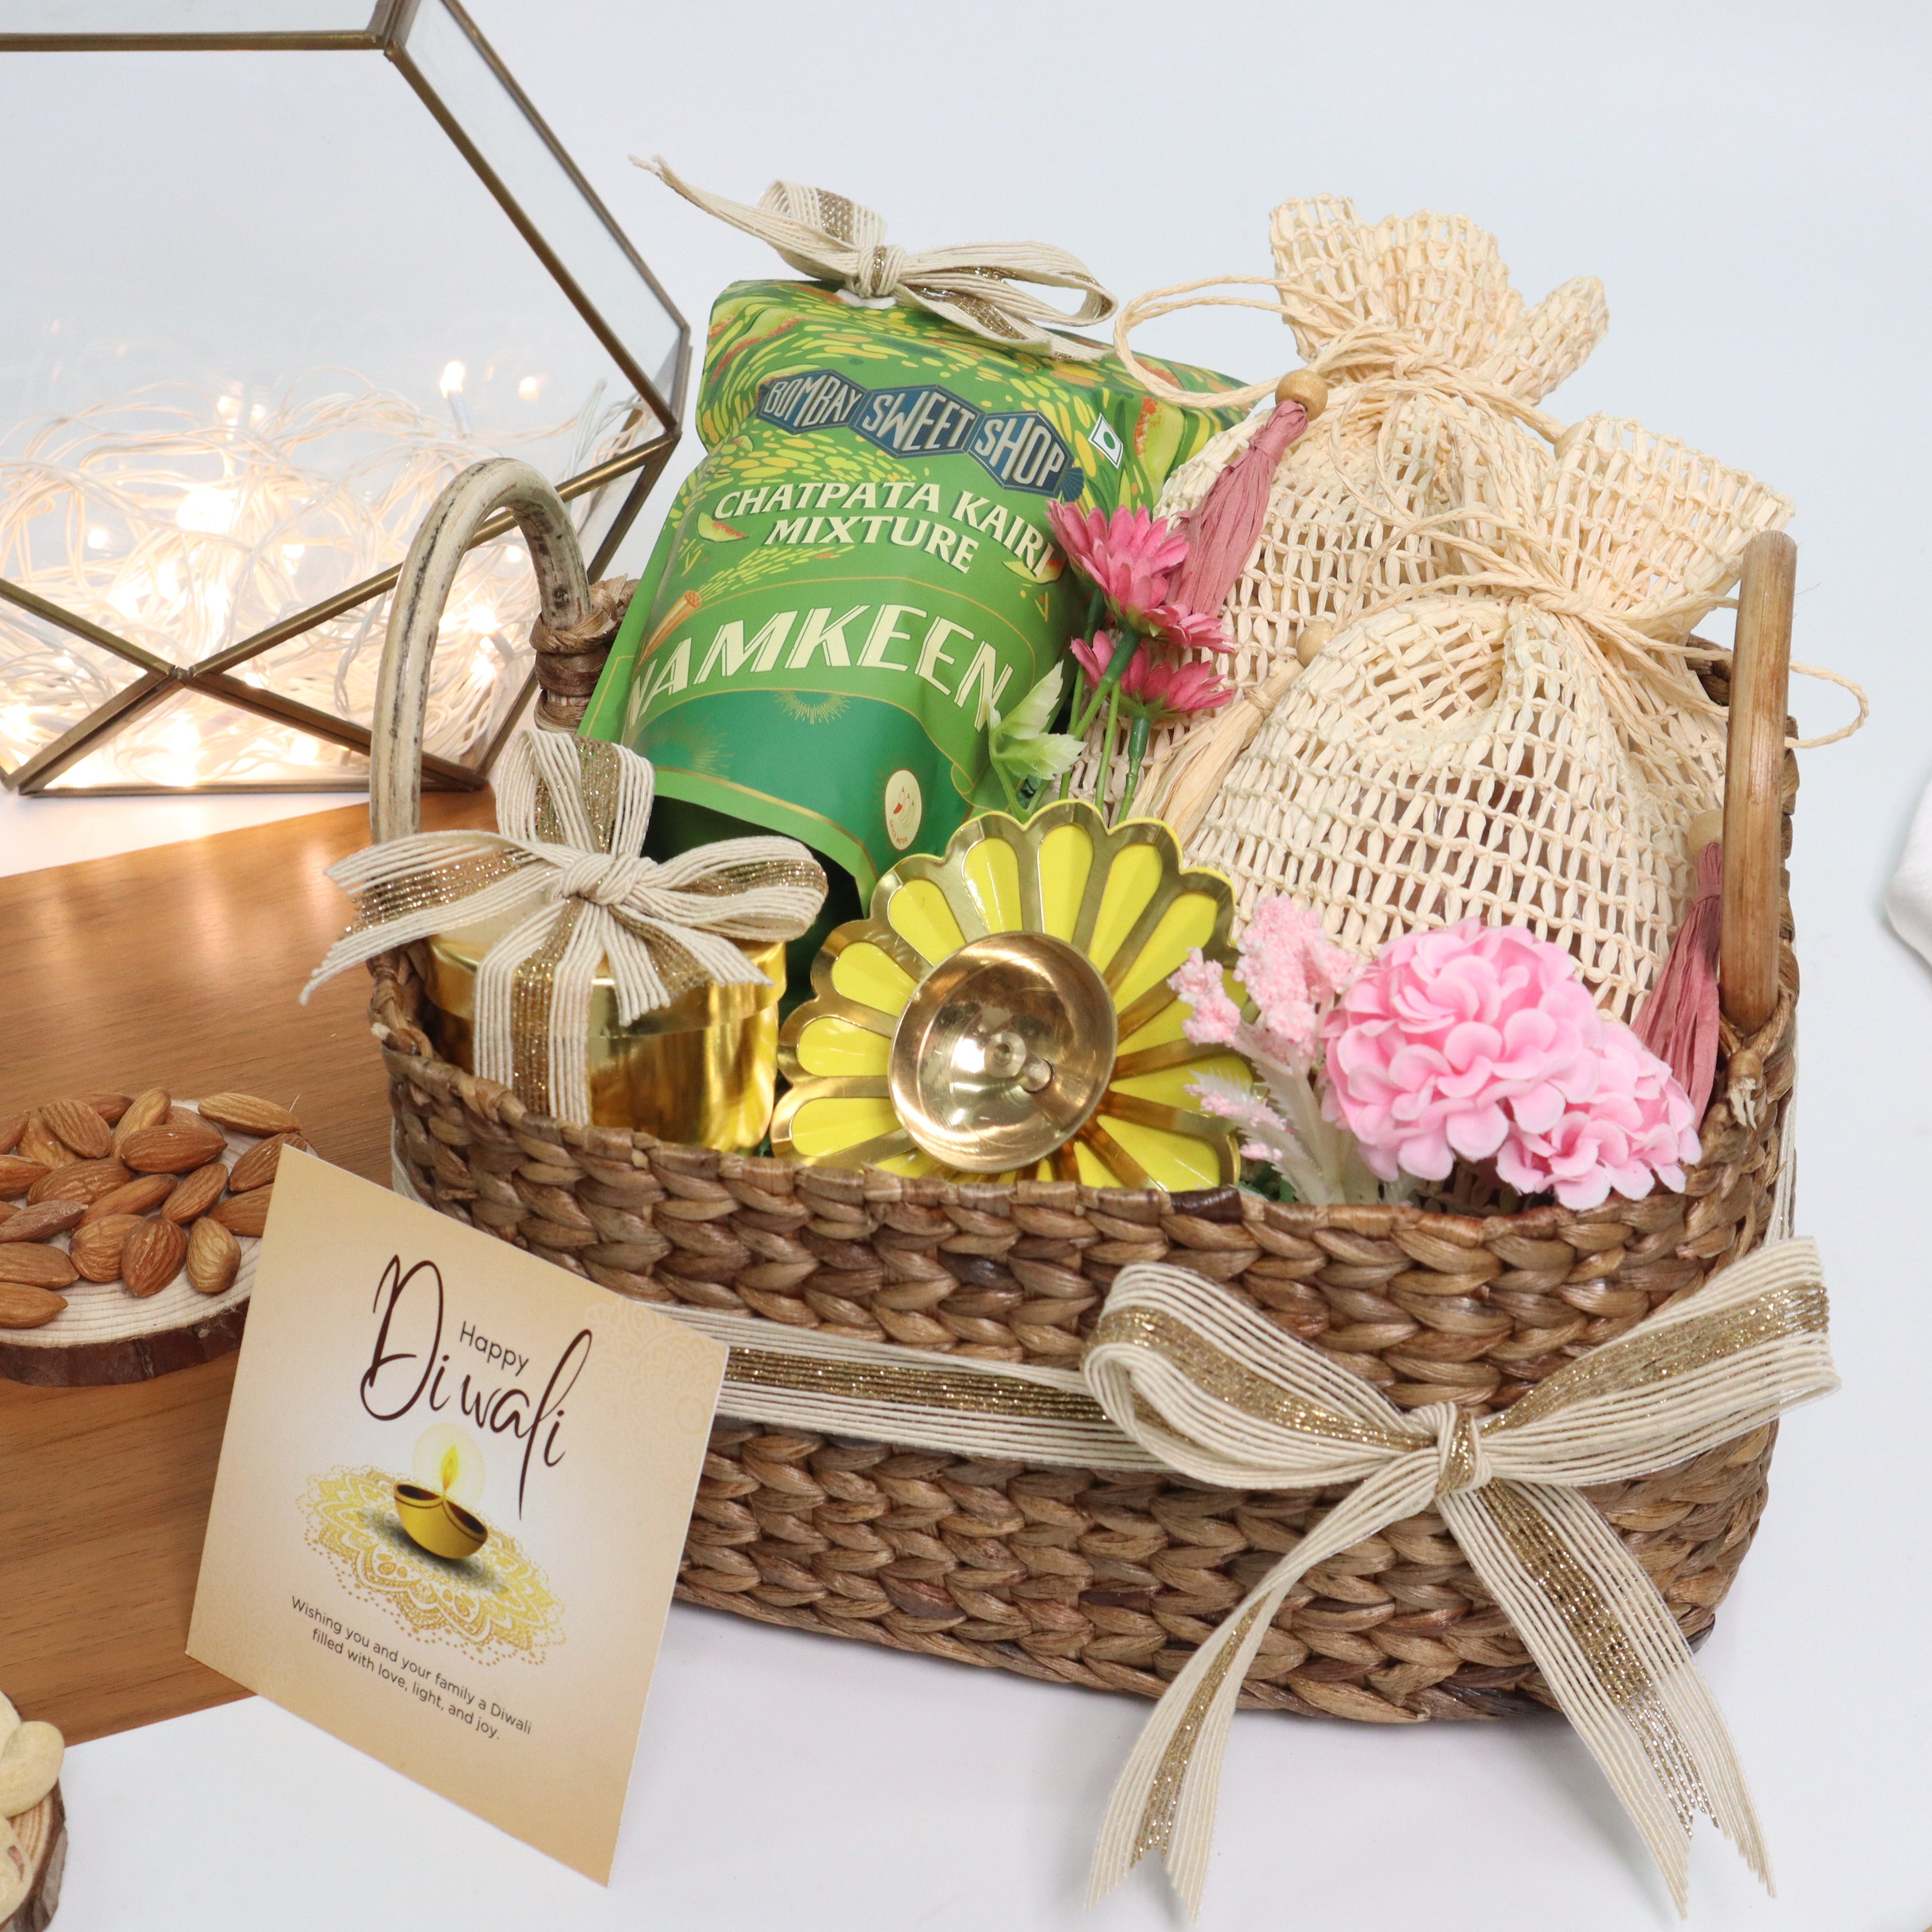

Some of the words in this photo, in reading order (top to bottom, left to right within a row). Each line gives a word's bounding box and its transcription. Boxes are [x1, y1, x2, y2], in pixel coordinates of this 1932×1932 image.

[763, 376, 863, 426] BOMBAY
[864, 392, 976, 452] SWEET
[976, 416, 1065, 487] SHOP
[714, 482, 940, 519] CHATPATA
[951, 490, 1055, 577] KAIRI
[764, 516, 979, 573] MIXTURE
[360, 1254, 592, 1520] Diwali
[459, 1321, 529, 1376] Happy
[292, 1596, 342, 1635] Wishing
[346, 1627, 370, 1648] you
[373, 1643, 398, 1663] and
[402, 1657, 431, 1680] your
[434, 1673, 475, 1705] family
[478, 1699, 486, 1710] a
[490, 1703, 532, 1735] Diwali
[312, 1629, 343, 1654] filled
[347, 1648, 375, 1672] with
[378, 1663, 408, 1691] love,
[412, 1681, 444, 1711] light,
[448, 1704, 473, 1724] and
[476, 1717, 500, 1740] joy.
